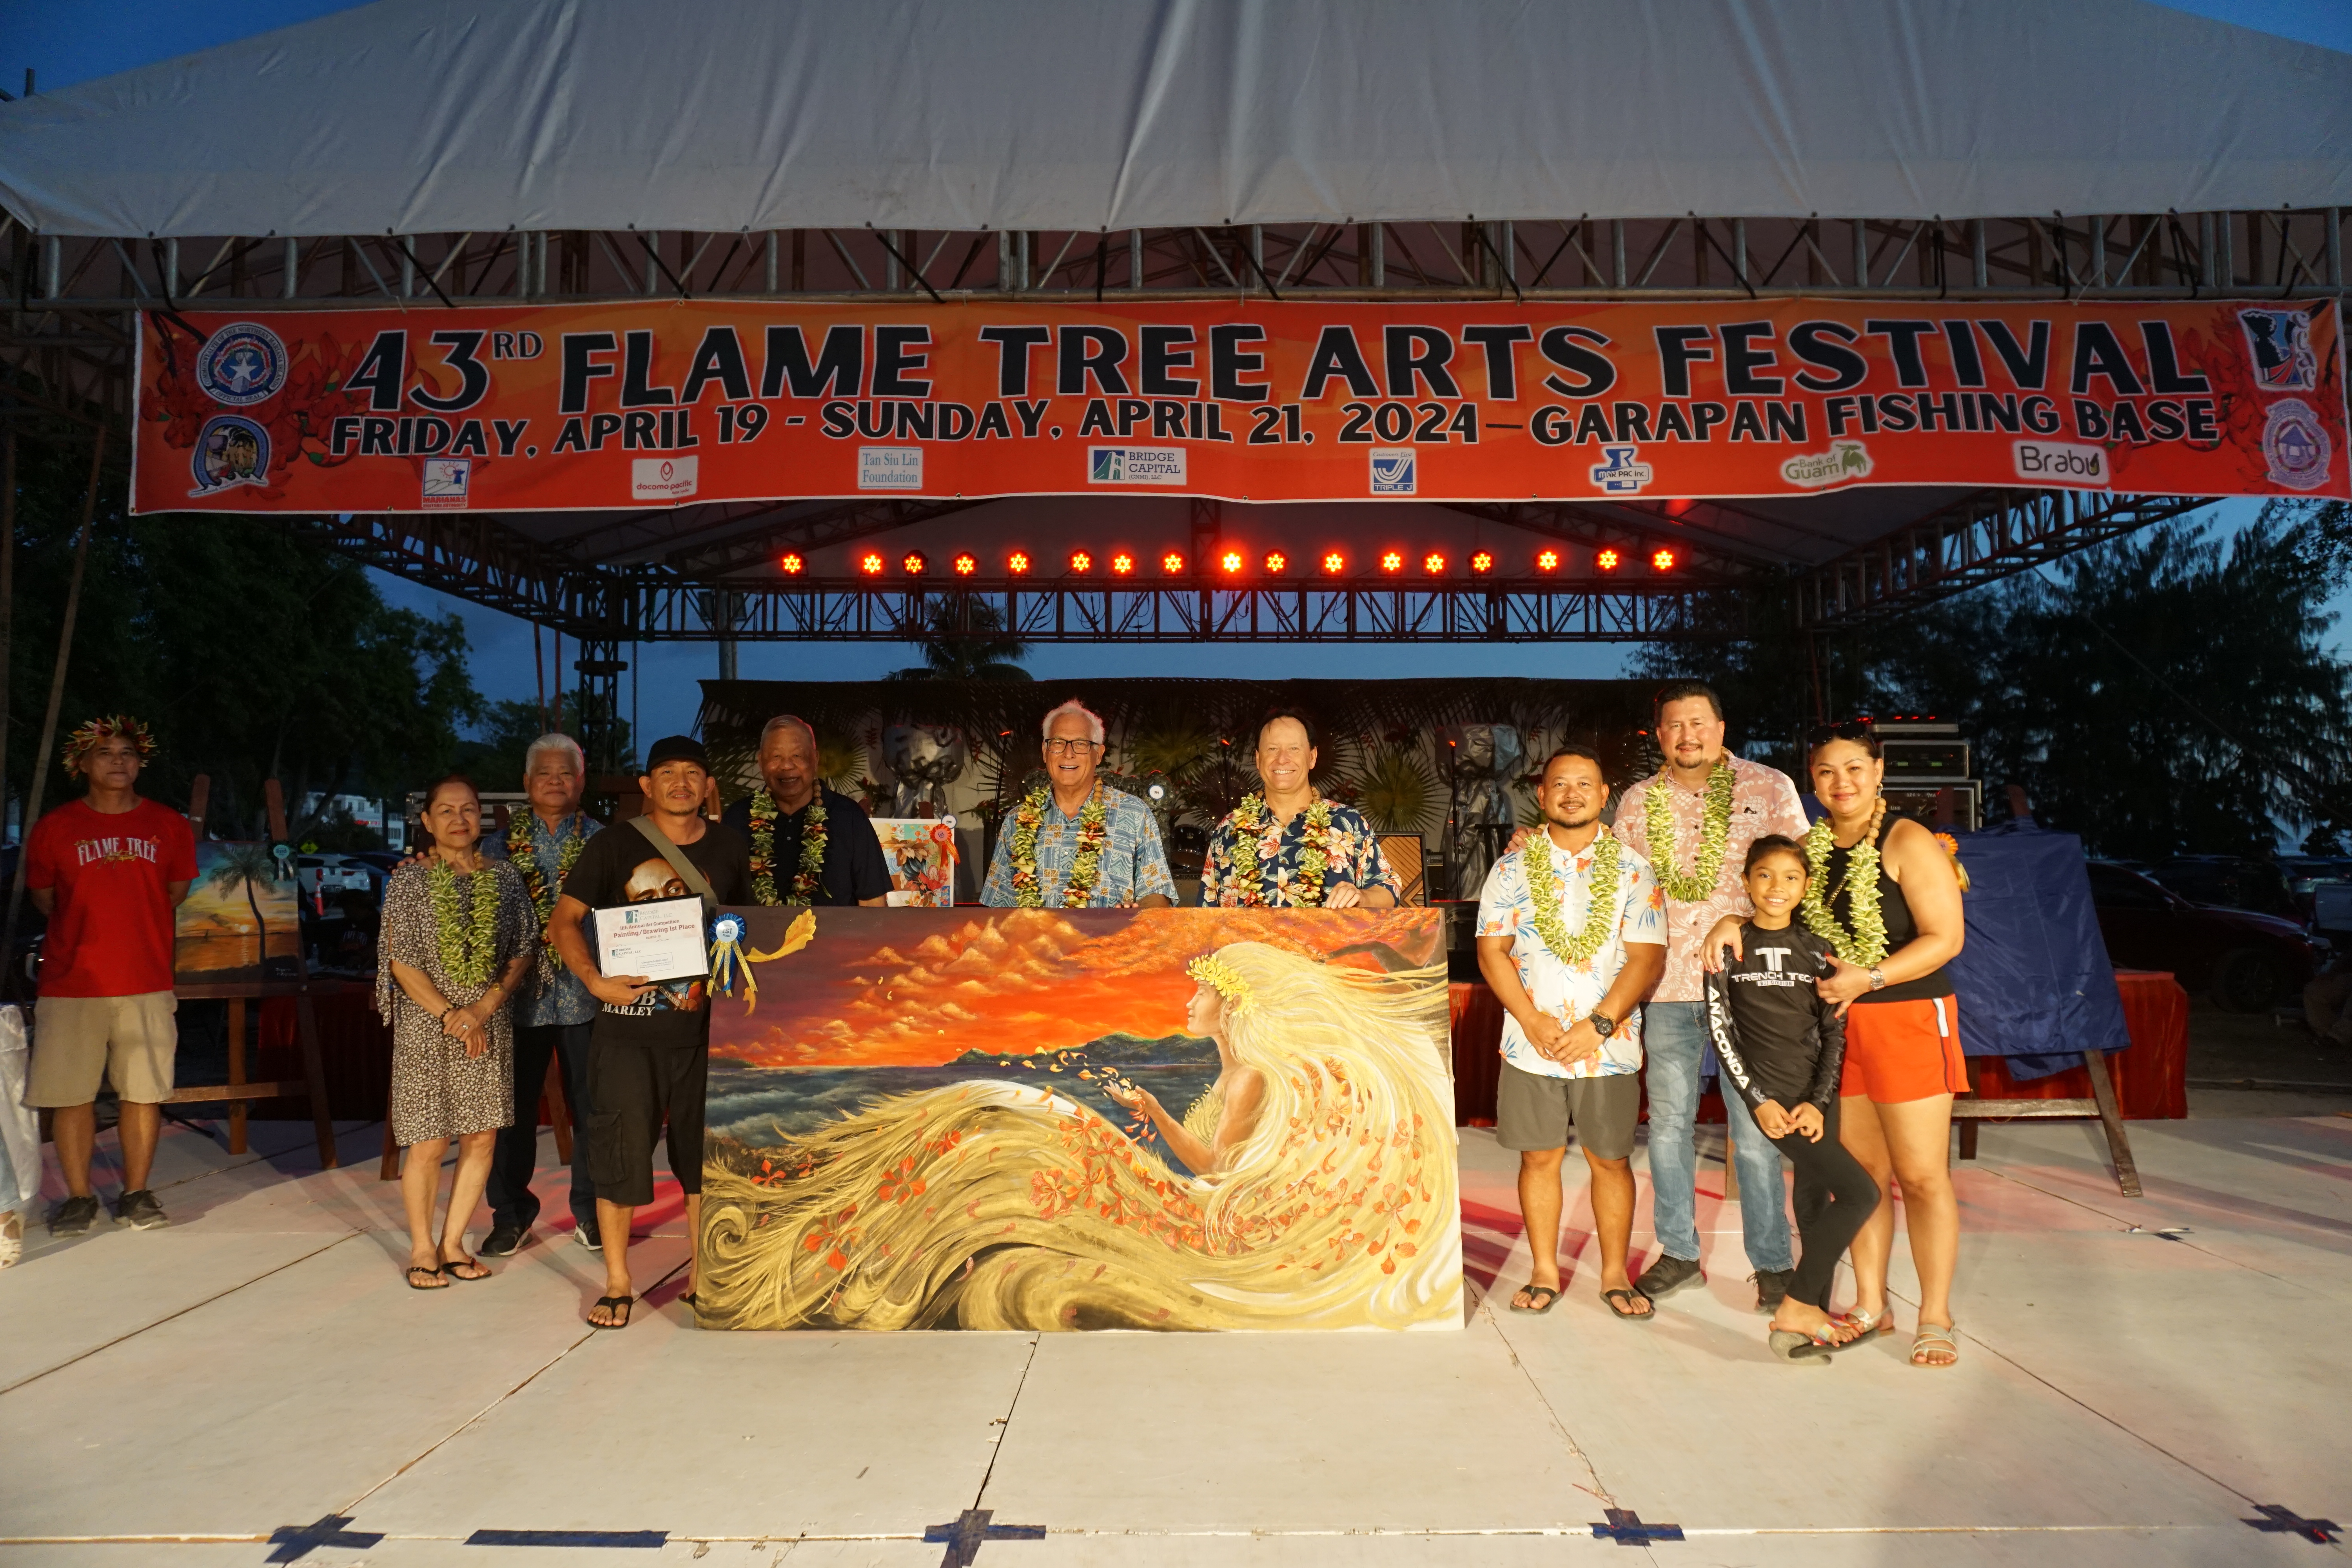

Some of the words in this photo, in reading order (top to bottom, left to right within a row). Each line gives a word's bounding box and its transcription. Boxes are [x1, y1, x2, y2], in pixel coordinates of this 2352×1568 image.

[559, 325, 933, 413] FLAME
[978, 322, 1271, 402] TREE
[1299, 323, 1617, 400] ARTS
[1654, 319, 2212, 397] FESTIVAL
[329, 416, 537, 458] FRIDAY,
[552, 409, 699, 453] APRIL
[715, 404, 769, 444] 19
[820, 398, 1063, 441] SUNDAY,
[1078, 397, 1234, 444] APRIL
[1338, 401, 1479, 444] 2024
[1529, 400, 1808, 445] GARAPAN
[1824, 392, 2061, 436] FISHING
[2073, 398, 2219, 443] BASE
[863, 453, 881, 465] Tan
[884, 453, 899, 465] Siu
[902, 453, 918, 466] Lin
[1129, 452, 1174, 462] BRIDGE
[1799, 457, 1824, 468] Bank
[1826, 454, 1837, 463] of
[2020, 446, 2100, 476] Brabu
[1129, 463, 1181, 474] CAPITAL
[1786, 463, 1839, 479] Guam
[862, 470, 918, 483] Foundation
[670, 479, 692, 491] pacific
[77, 837, 120, 866] FLAME
[126, 837, 158, 864] TREE
[613, 927, 668, 938] Painting/Drawing
[1731, 971, 1783, 983] TRENCH
[602, 1002, 655, 1016] MARLEY
[1709, 985, 1749, 1090] ANACONDA
